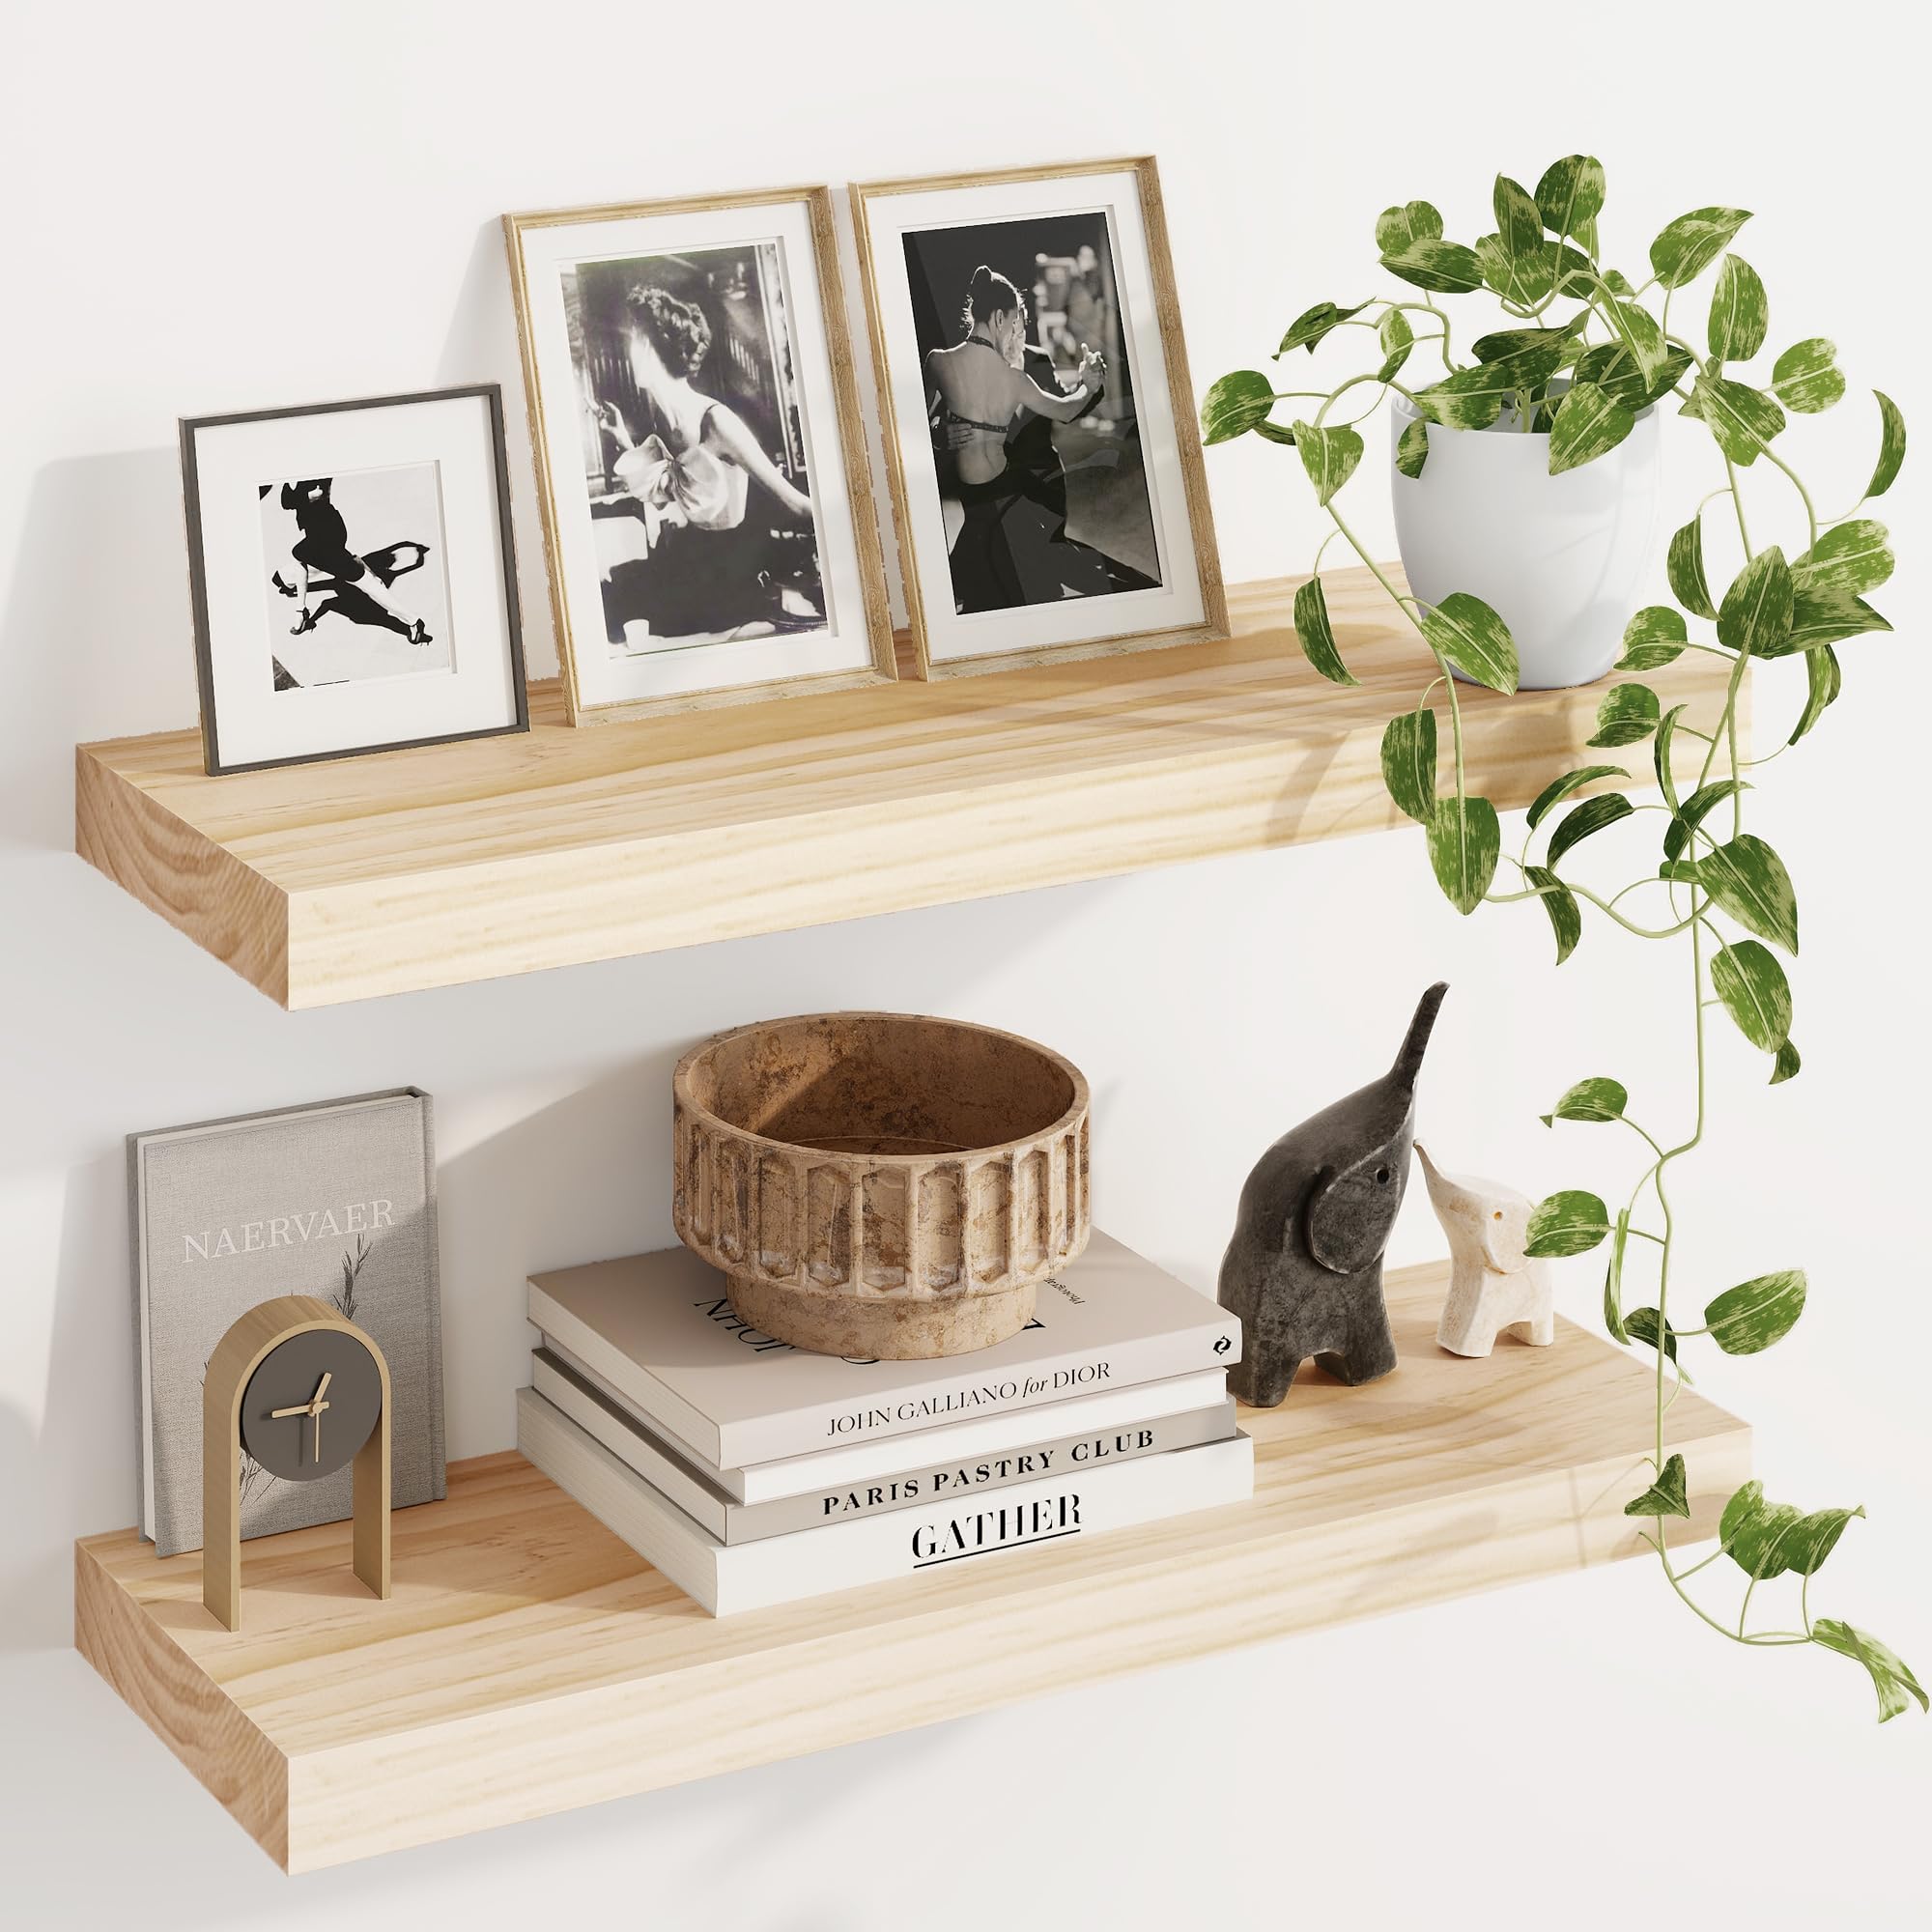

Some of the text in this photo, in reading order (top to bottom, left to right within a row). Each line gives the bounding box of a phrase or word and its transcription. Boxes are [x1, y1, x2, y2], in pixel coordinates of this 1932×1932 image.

[182, 1199, 396, 1264] NAERVAER
[827, 1362, 1110, 1436] JOHN GALLIANO for DIOR
[823, 1430, 1154, 1516] PARIS PASTRY CLUB
[912, 1493, 1083, 1559] GATHER
